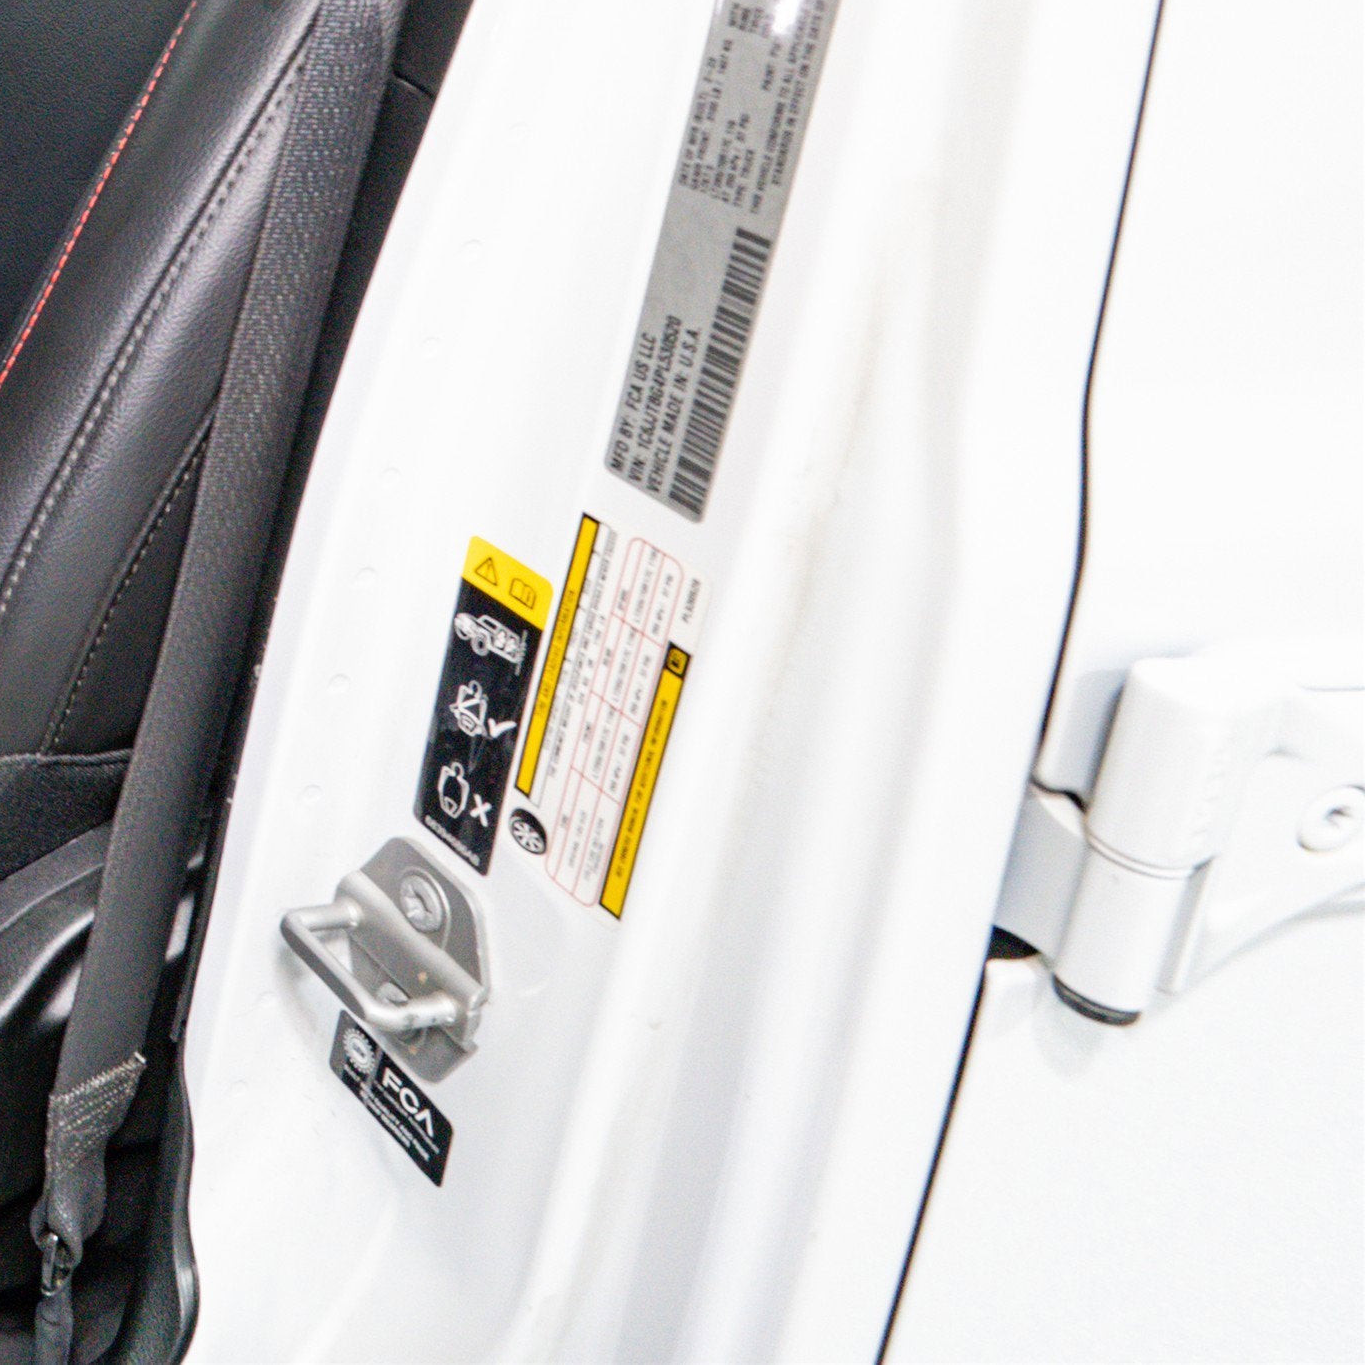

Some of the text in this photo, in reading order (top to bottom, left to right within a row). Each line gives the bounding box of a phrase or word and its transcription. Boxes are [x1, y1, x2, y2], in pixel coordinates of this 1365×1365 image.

[637, 331, 656, 360] LLC
[631, 358, 649, 382] US
[624, 382, 644, 412] FCA
[646, 435, 672, 494] VEHICLE
[660, 392, 683, 436] MADE
[380, 1068, 435, 1139] FCA
